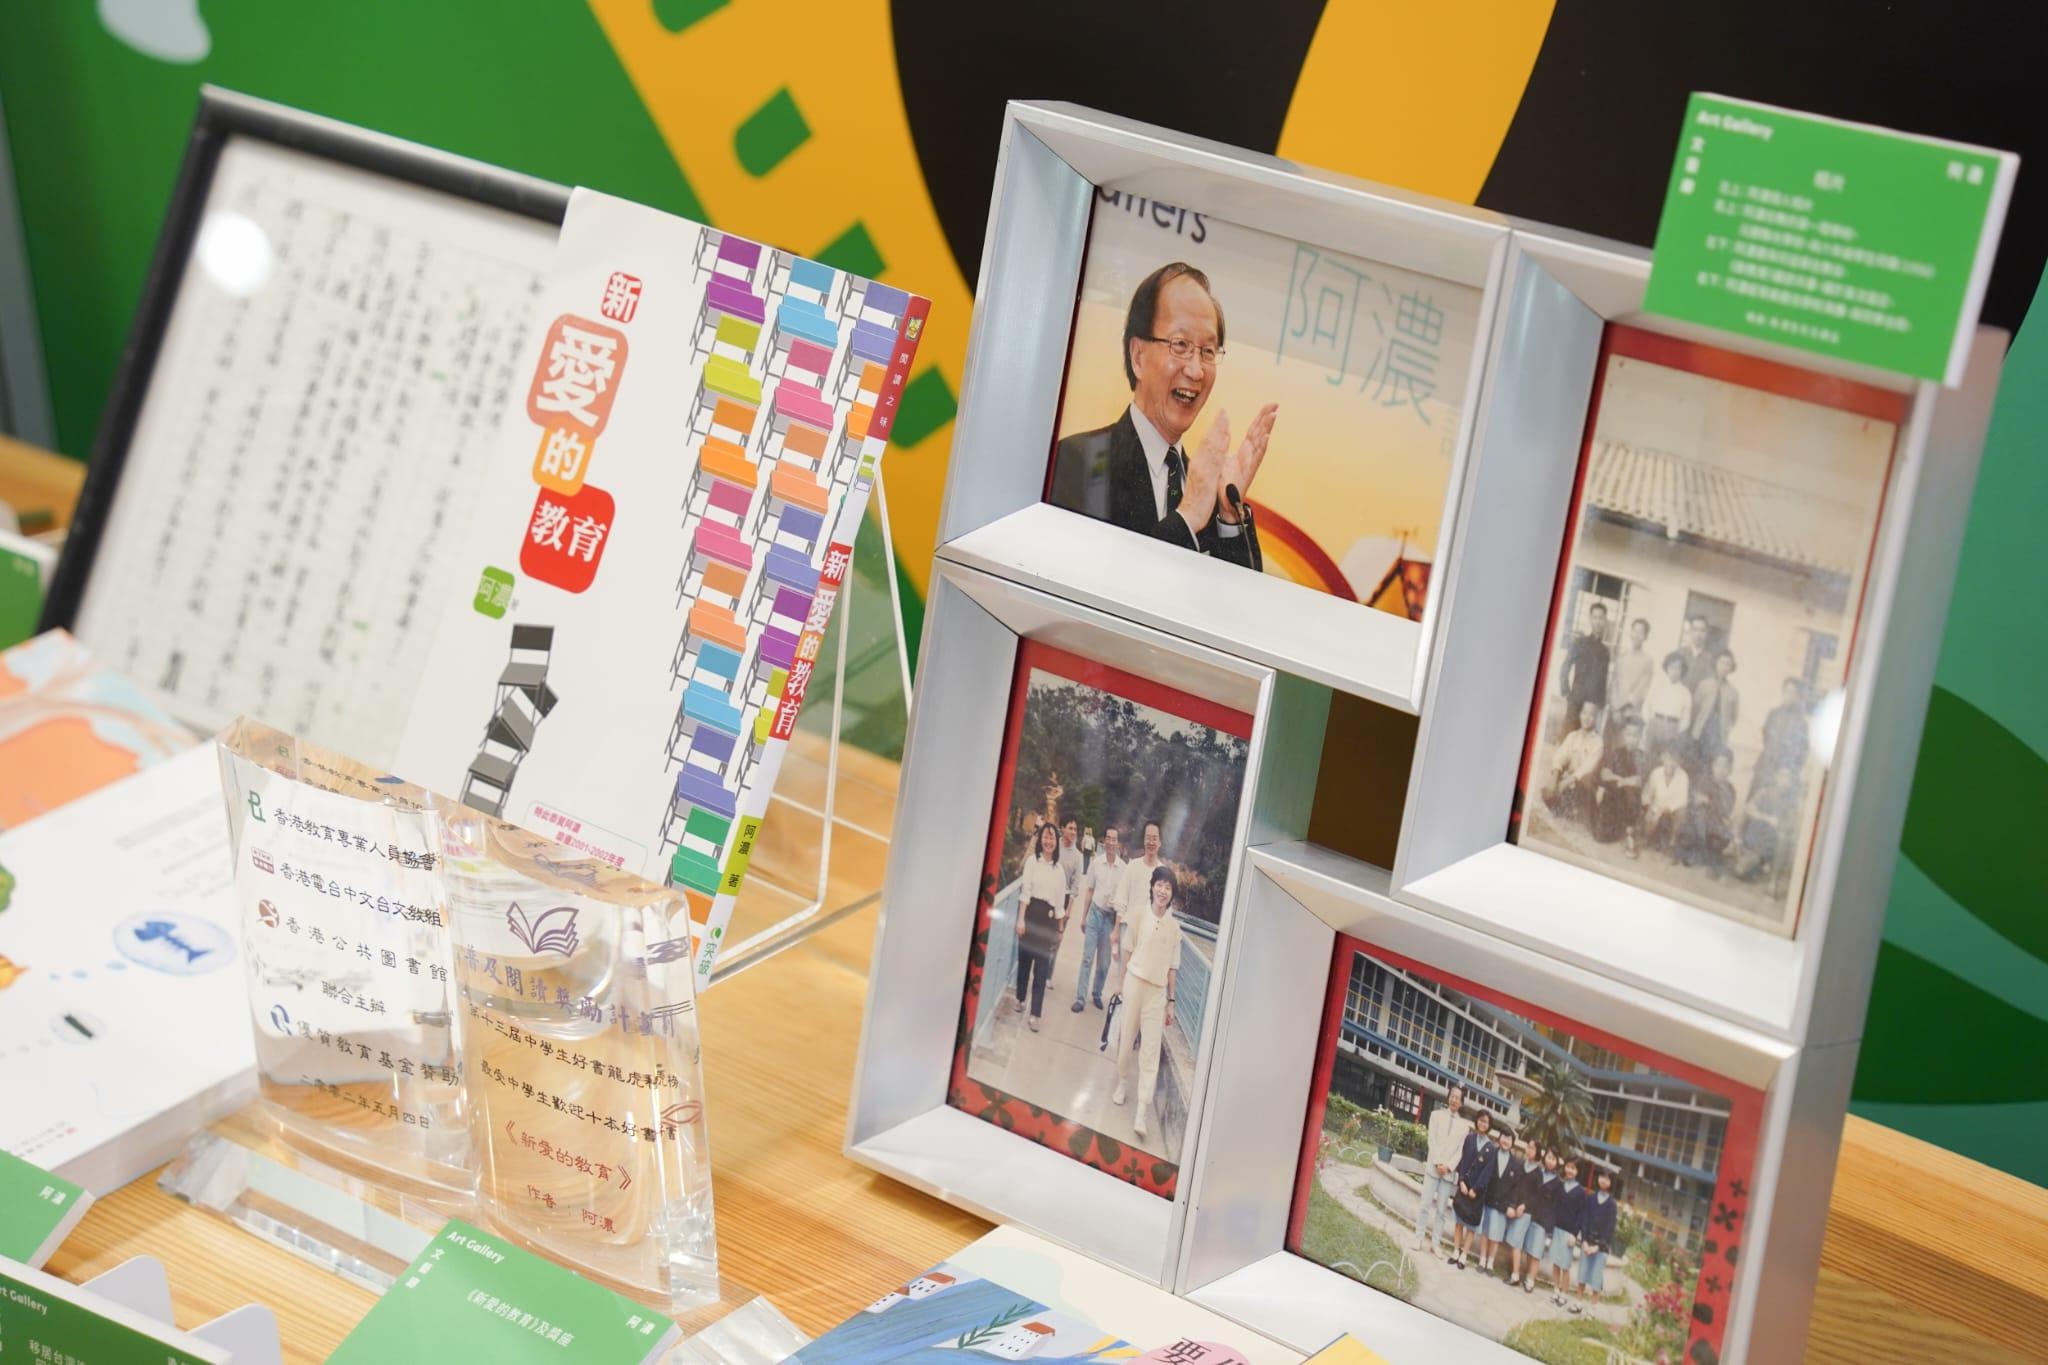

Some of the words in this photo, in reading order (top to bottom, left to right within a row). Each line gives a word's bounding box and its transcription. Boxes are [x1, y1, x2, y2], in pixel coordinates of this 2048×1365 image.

[601, 271, 643, 322] 新
[1276, 244, 1445, 427] 阿濃
[537, 324, 618, 428] 愛
[541, 428, 586, 481] 的
[531, 500, 608, 563] 教育
[775, 549, 850, 738] 新愛的教育
[285, 915, 448, 982] 香港公共圖書館
[504, 1118, 632, 1191] 《新愛的教育》
[447, 1231, 467, 1246] Art
[466, 1239, 505, 1264] Gallery
[9, 1289, 48, 1316] Gallery
